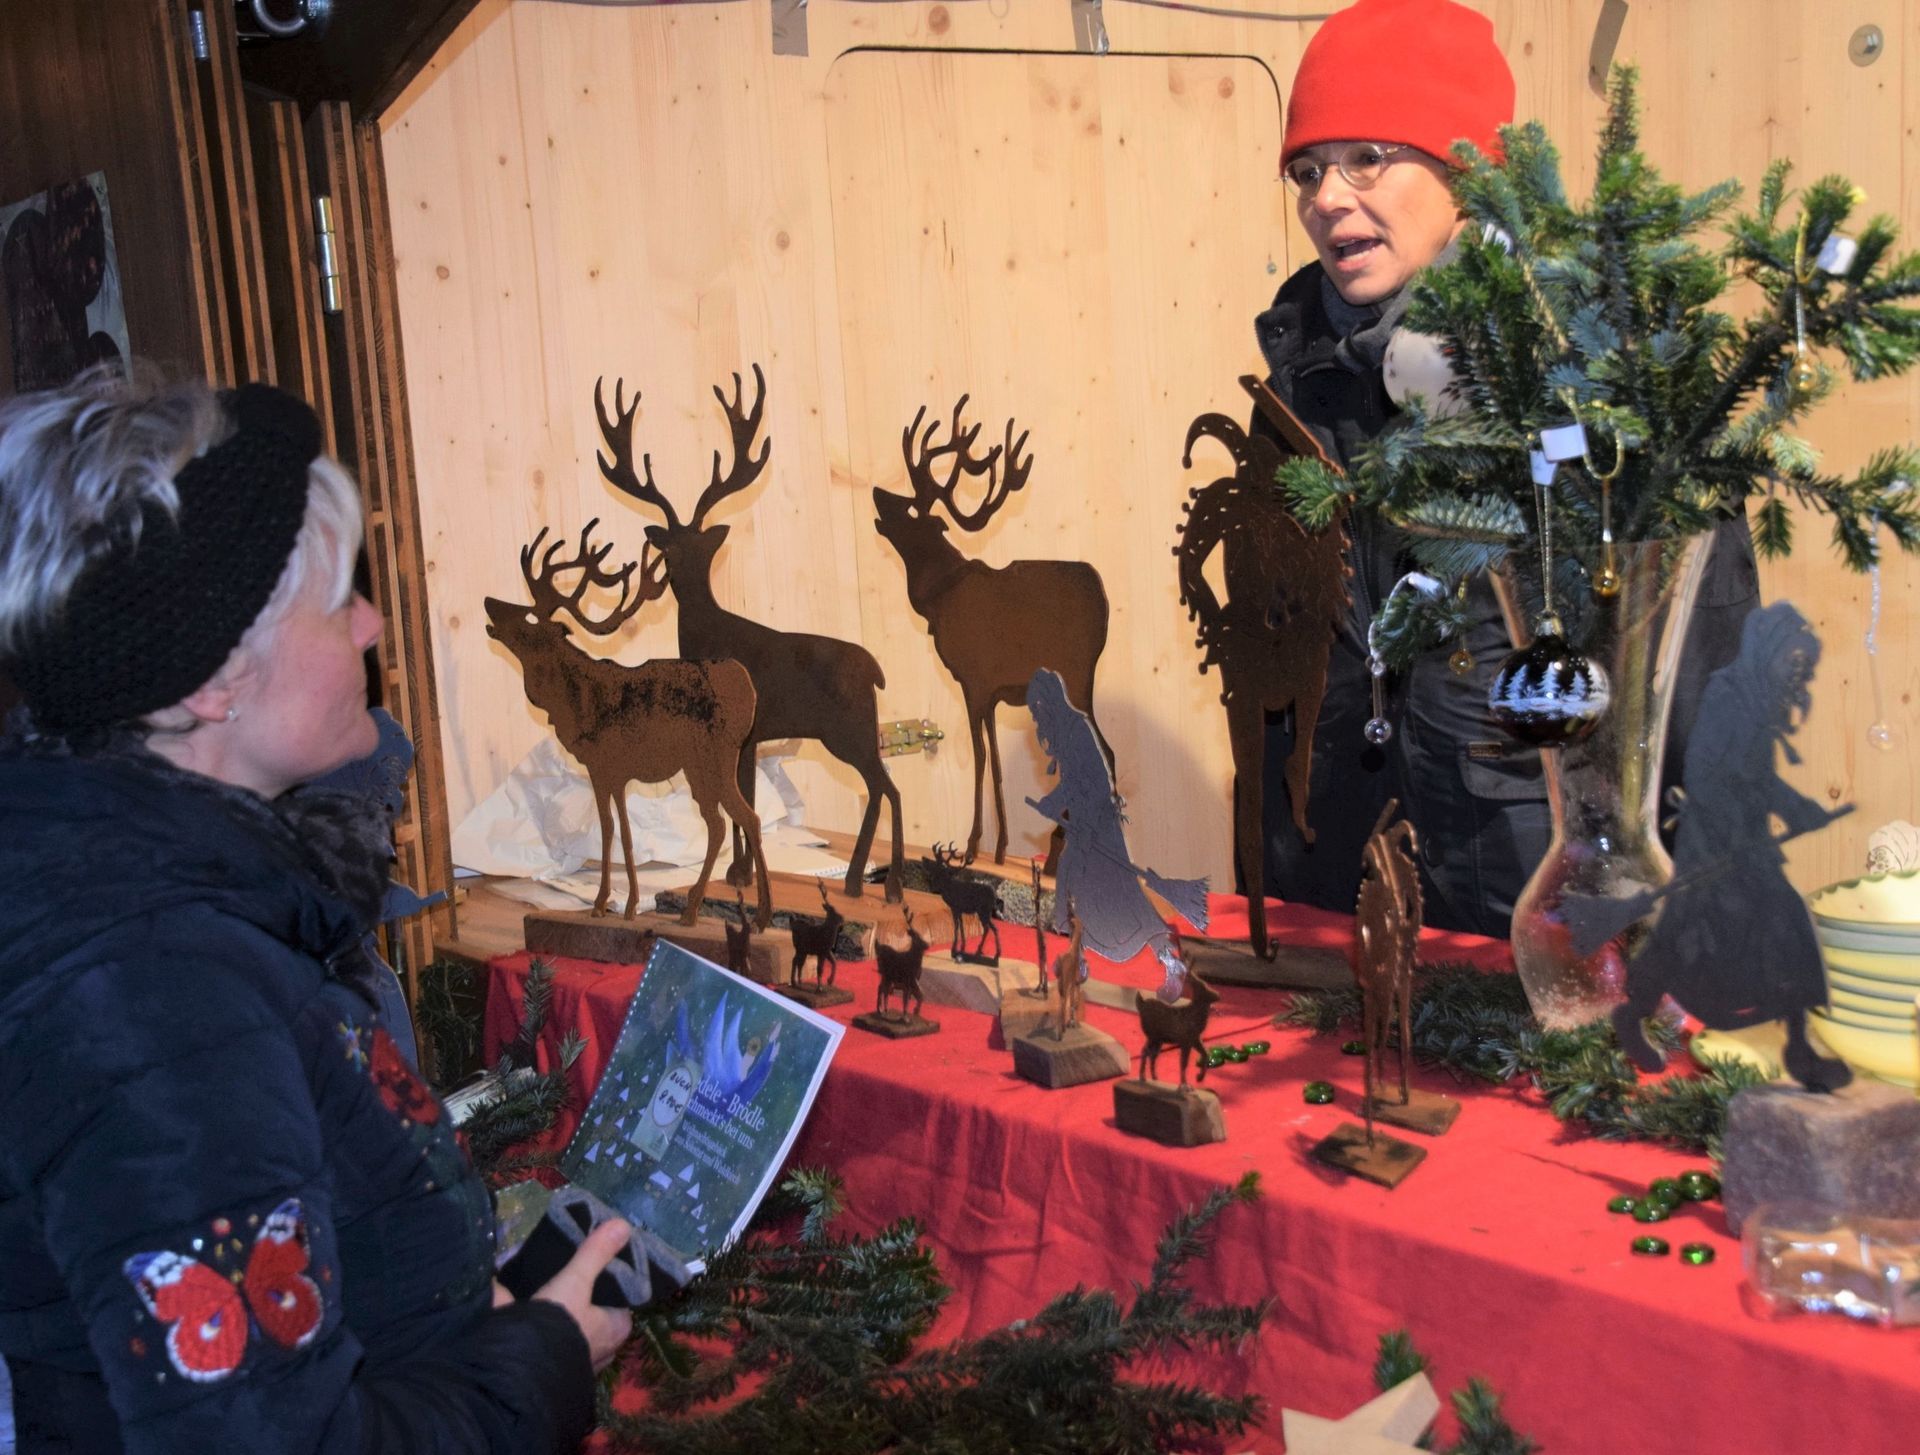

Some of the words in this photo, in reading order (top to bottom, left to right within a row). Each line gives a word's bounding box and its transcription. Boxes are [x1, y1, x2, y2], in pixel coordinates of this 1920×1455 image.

[687, 1095, 726, 1130] chmeckt's
[724, 1117, 741, 1139] bei
[737, 1131, 755, 1149] uns
[698, 1075, 722, 1104] dele
[726, 1092, 766, 1132] Brödle
